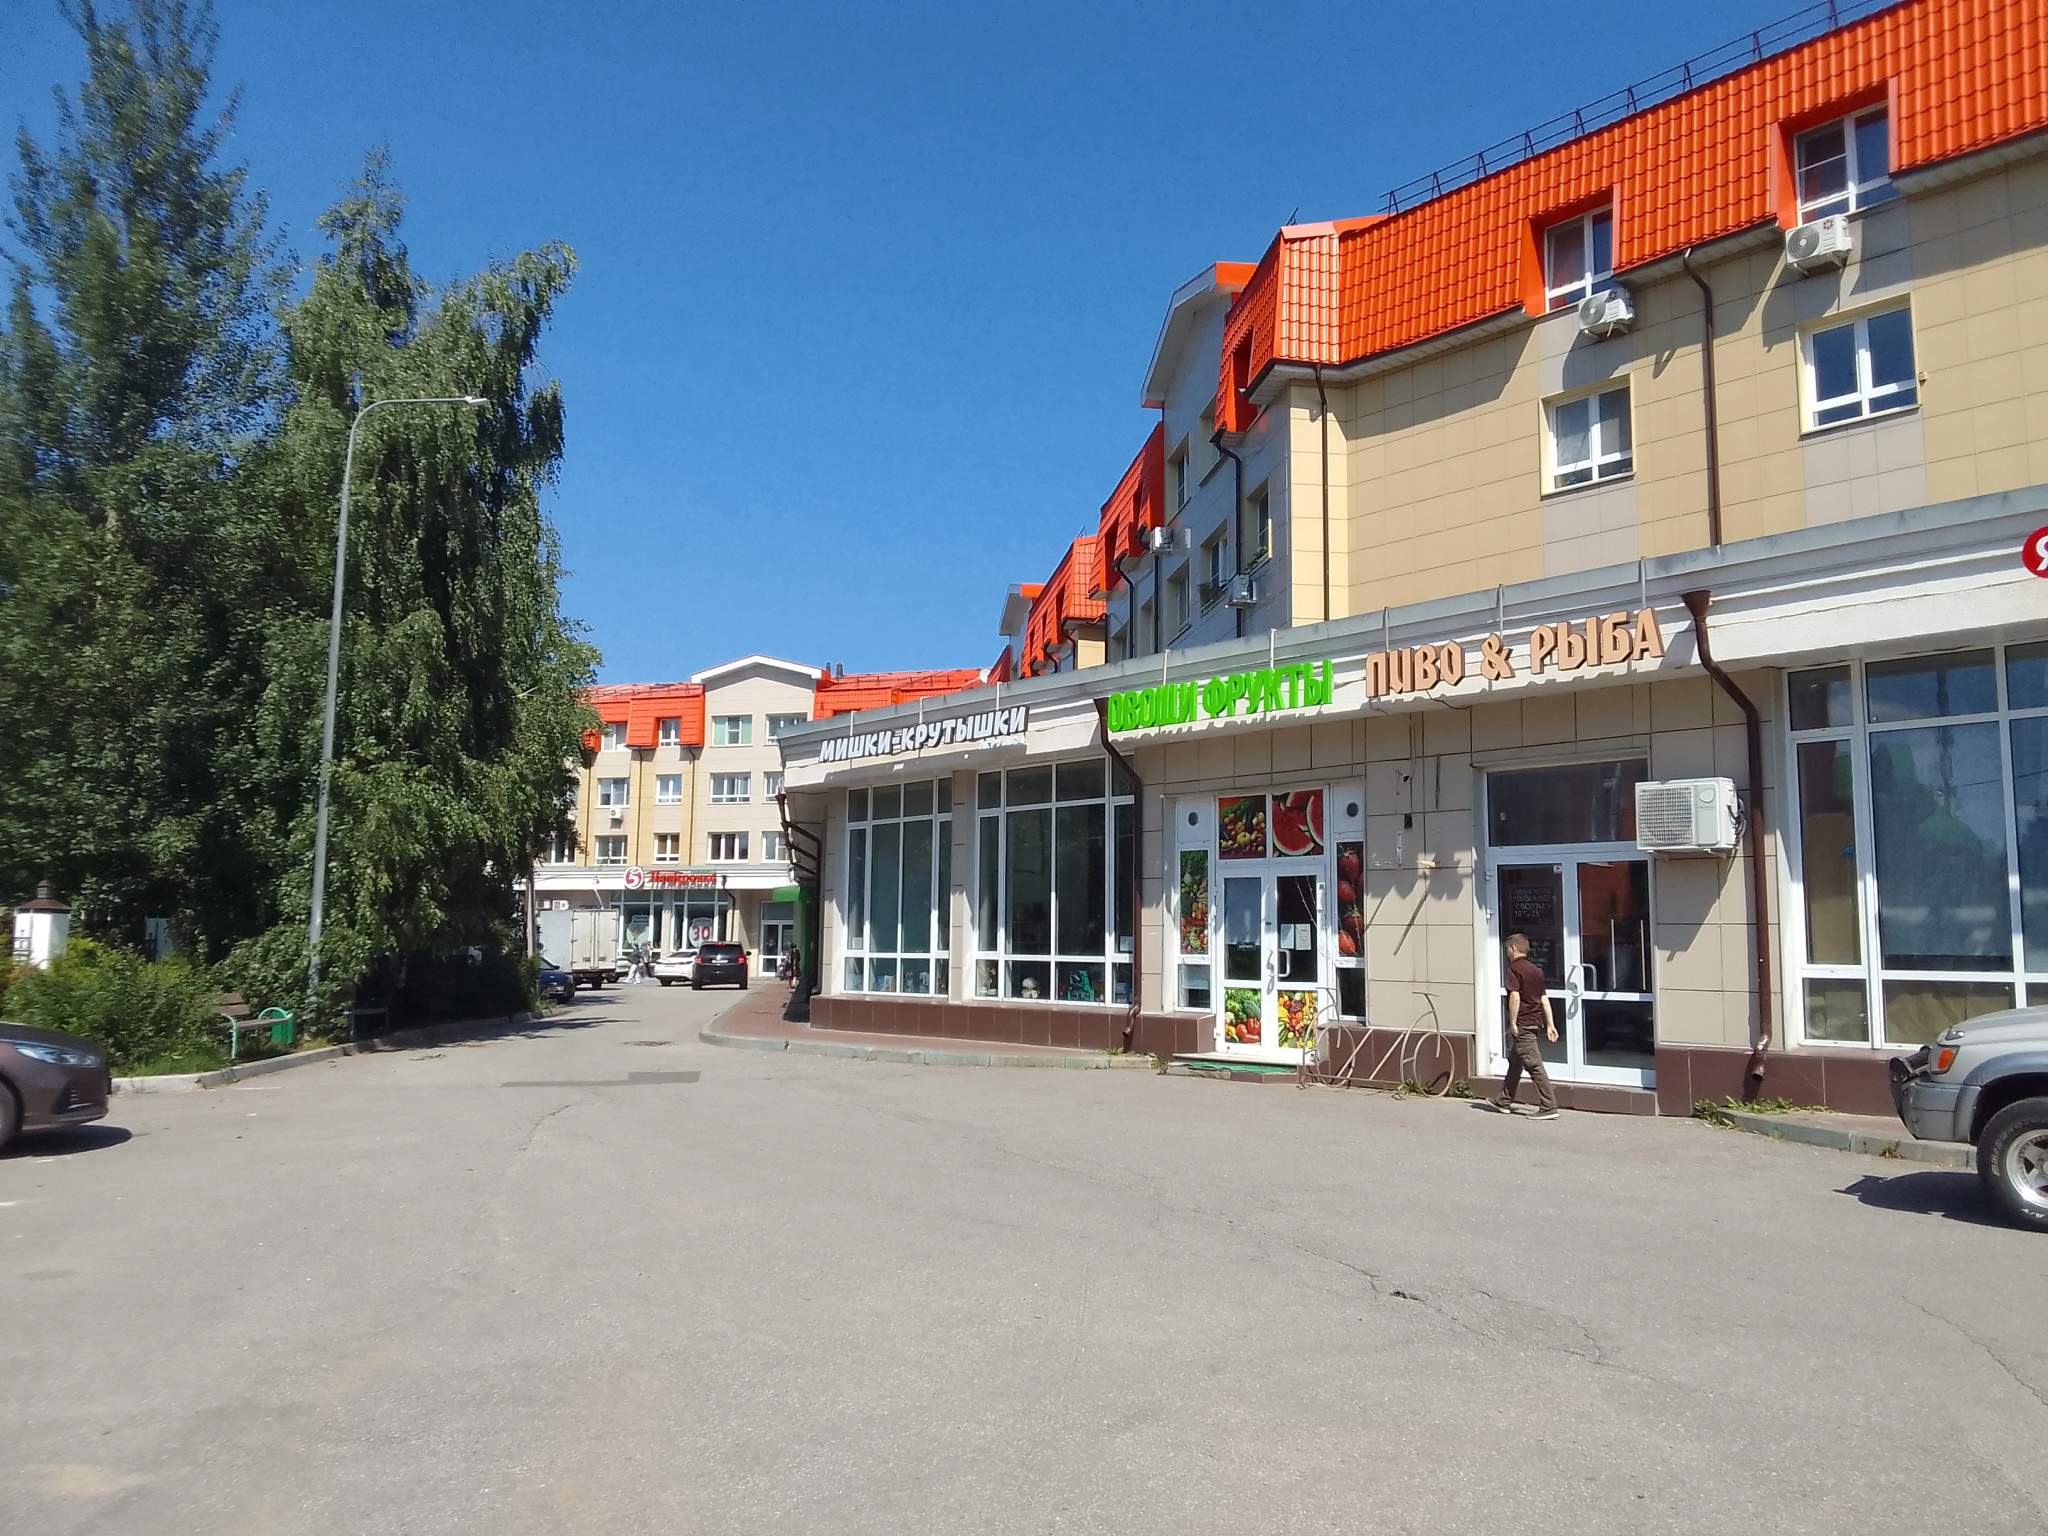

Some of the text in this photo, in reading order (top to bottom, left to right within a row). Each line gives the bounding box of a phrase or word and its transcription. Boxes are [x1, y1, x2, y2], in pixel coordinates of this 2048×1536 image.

[1203, 659, 1334, 719] ФРУКТЫ
[1366, 607, 1664, 697] ПИВО & РЫБА
